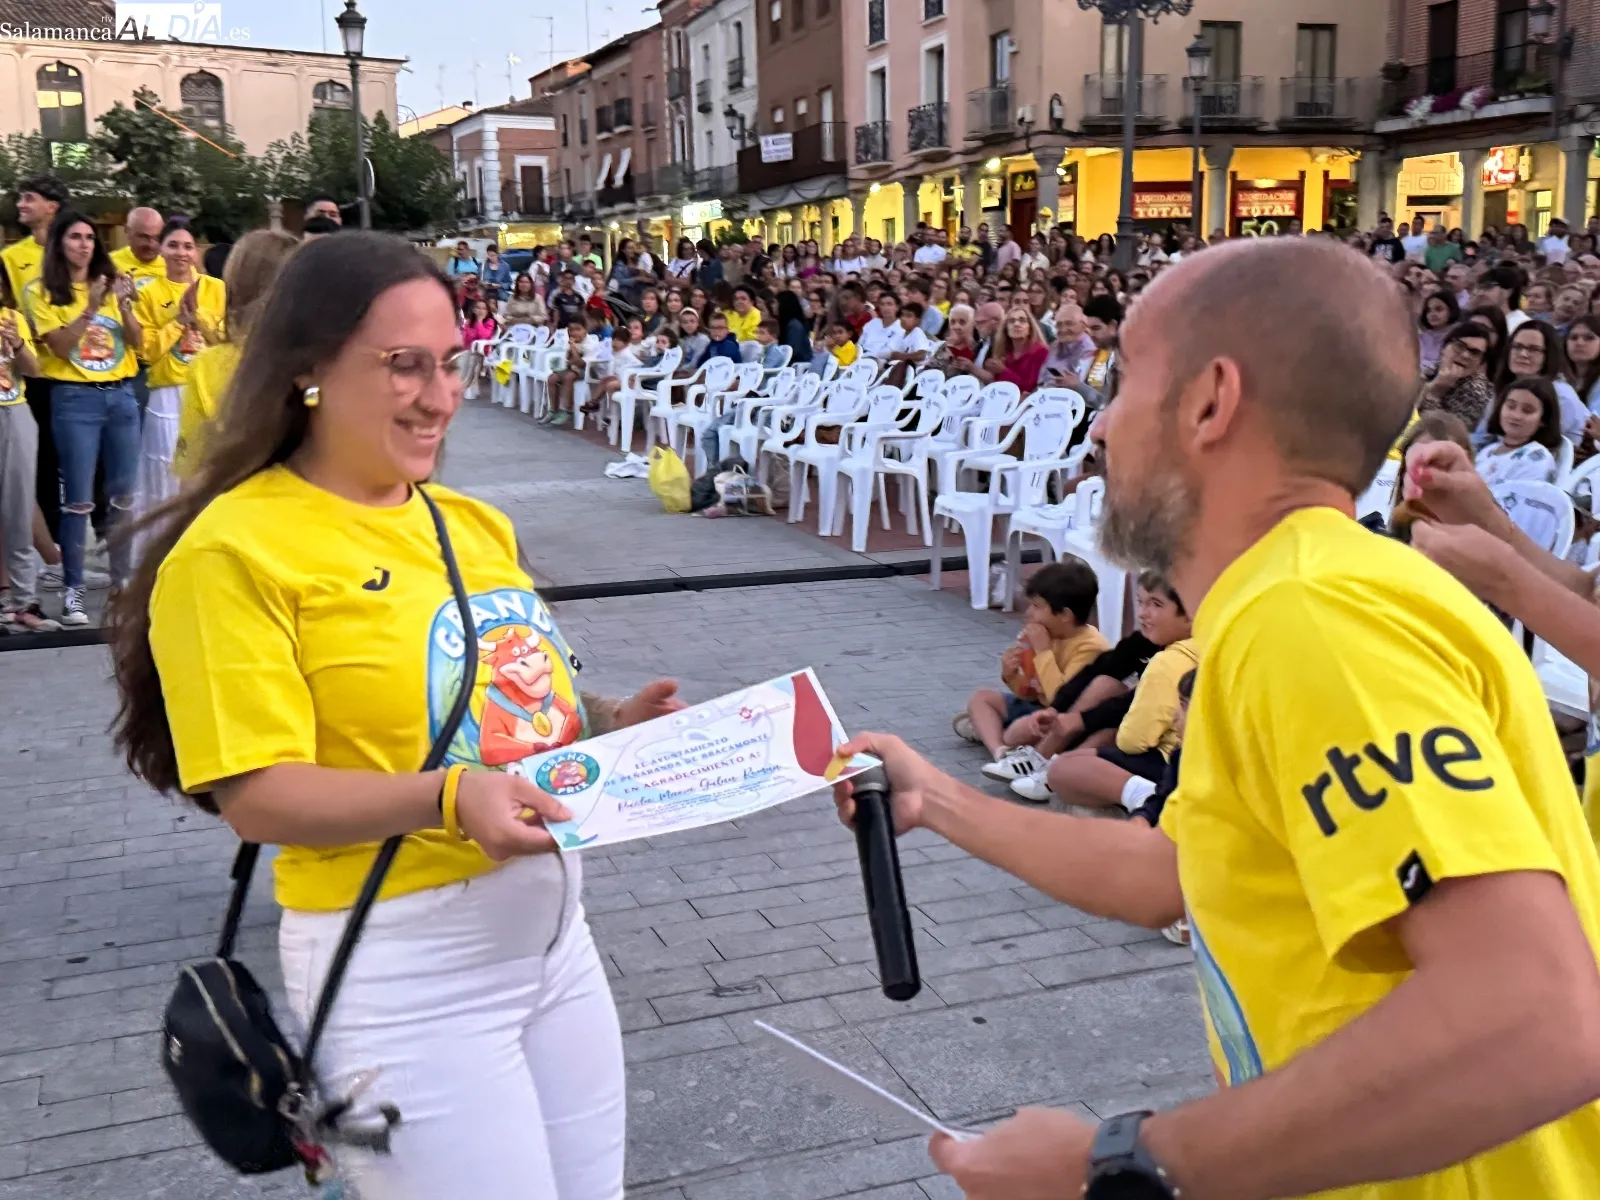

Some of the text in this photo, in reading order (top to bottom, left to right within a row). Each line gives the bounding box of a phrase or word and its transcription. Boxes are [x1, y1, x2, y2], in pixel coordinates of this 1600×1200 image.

[1135, 206, 1192, 219] TOTAL
[1238, 204, 1296, 218] TOTAL
[644, 756, 744, 789] AGRADECIMIENTO
[1301, 726, 1495, 837] rtve
